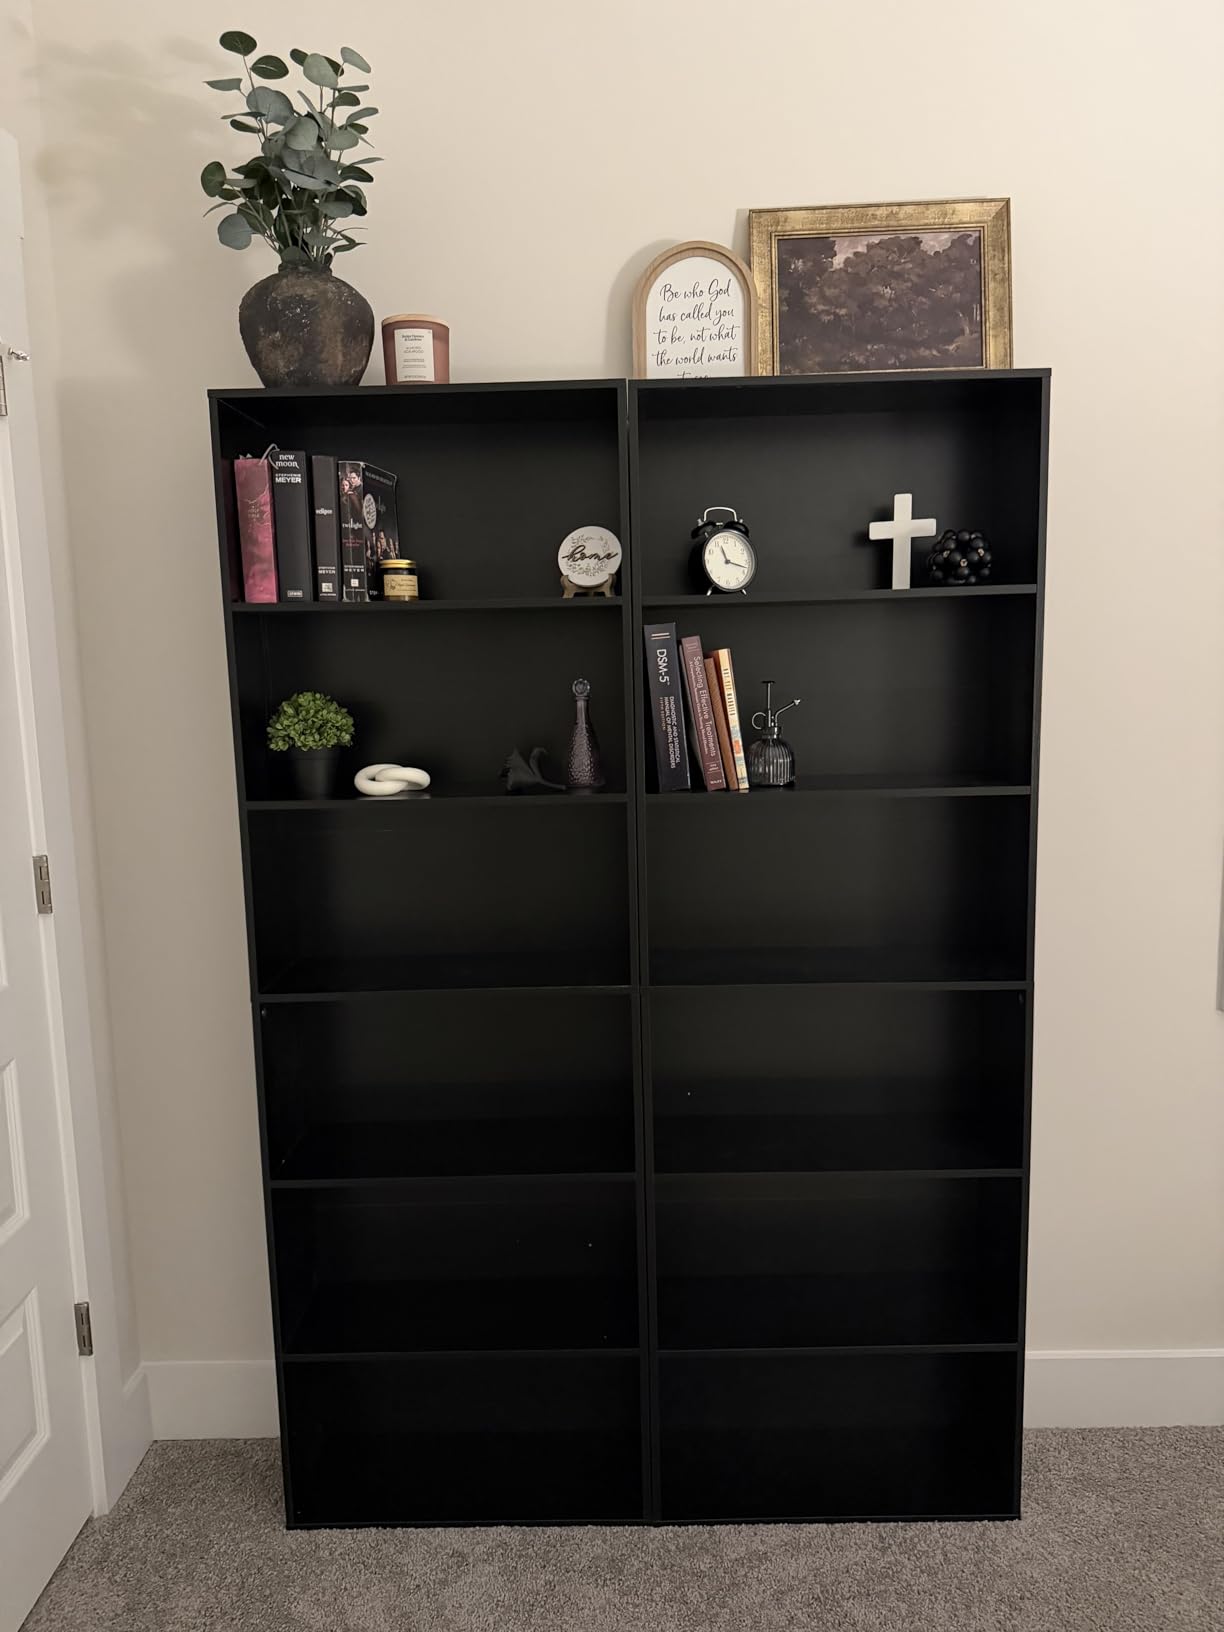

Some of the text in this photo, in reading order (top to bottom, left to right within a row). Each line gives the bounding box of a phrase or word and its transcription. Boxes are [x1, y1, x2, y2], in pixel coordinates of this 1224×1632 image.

[660, 278, 732, 302] Be who God
[659, 302, 734, 325] has called you
[653, 329, 667, 344] to
[690, 326, 711, 342] not
[709, 324, 740, 340] what
[652, 346, 738, 366] the world wants
[275, 461, 300, 469] moon
[693, 656, 704, 688] Selecting
[699, 689, 709, 719] Effective
[705, 720, 716, 757] Treatments
